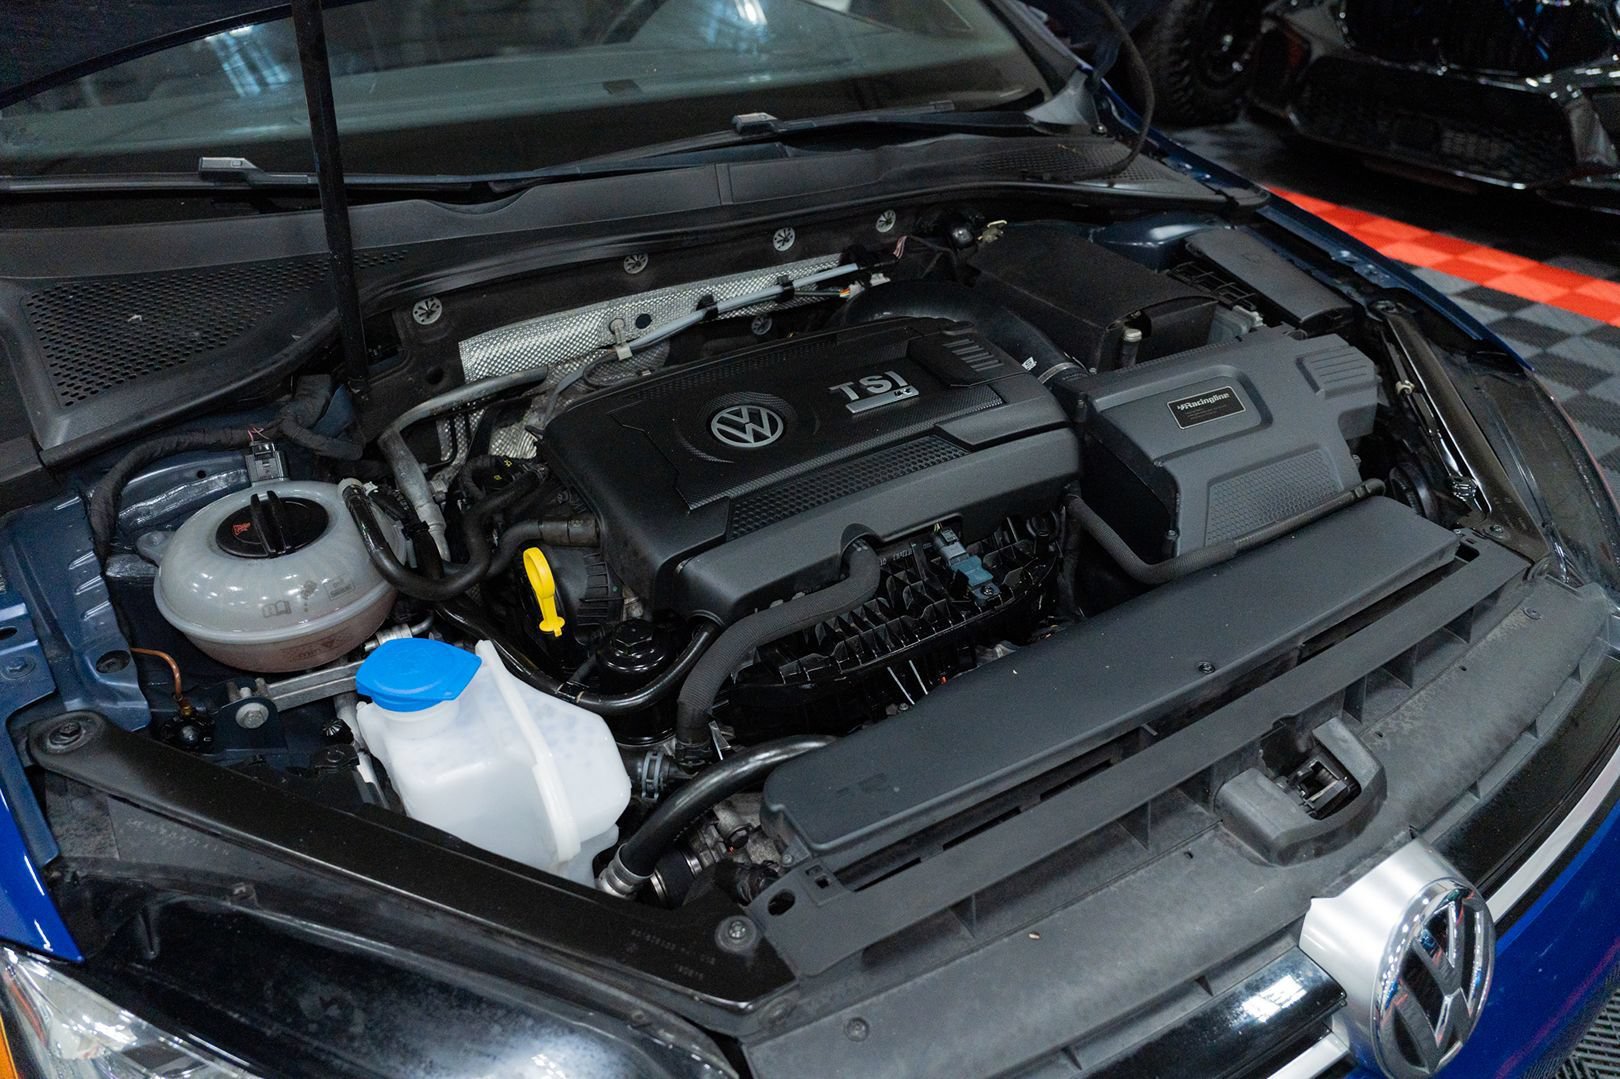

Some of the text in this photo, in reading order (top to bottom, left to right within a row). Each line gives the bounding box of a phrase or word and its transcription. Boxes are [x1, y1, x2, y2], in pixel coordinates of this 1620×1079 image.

[827, 370, 909, 401] TSI
[711, 404, 784, 448] VW
[1373, 884, 1492, 1077] VW
